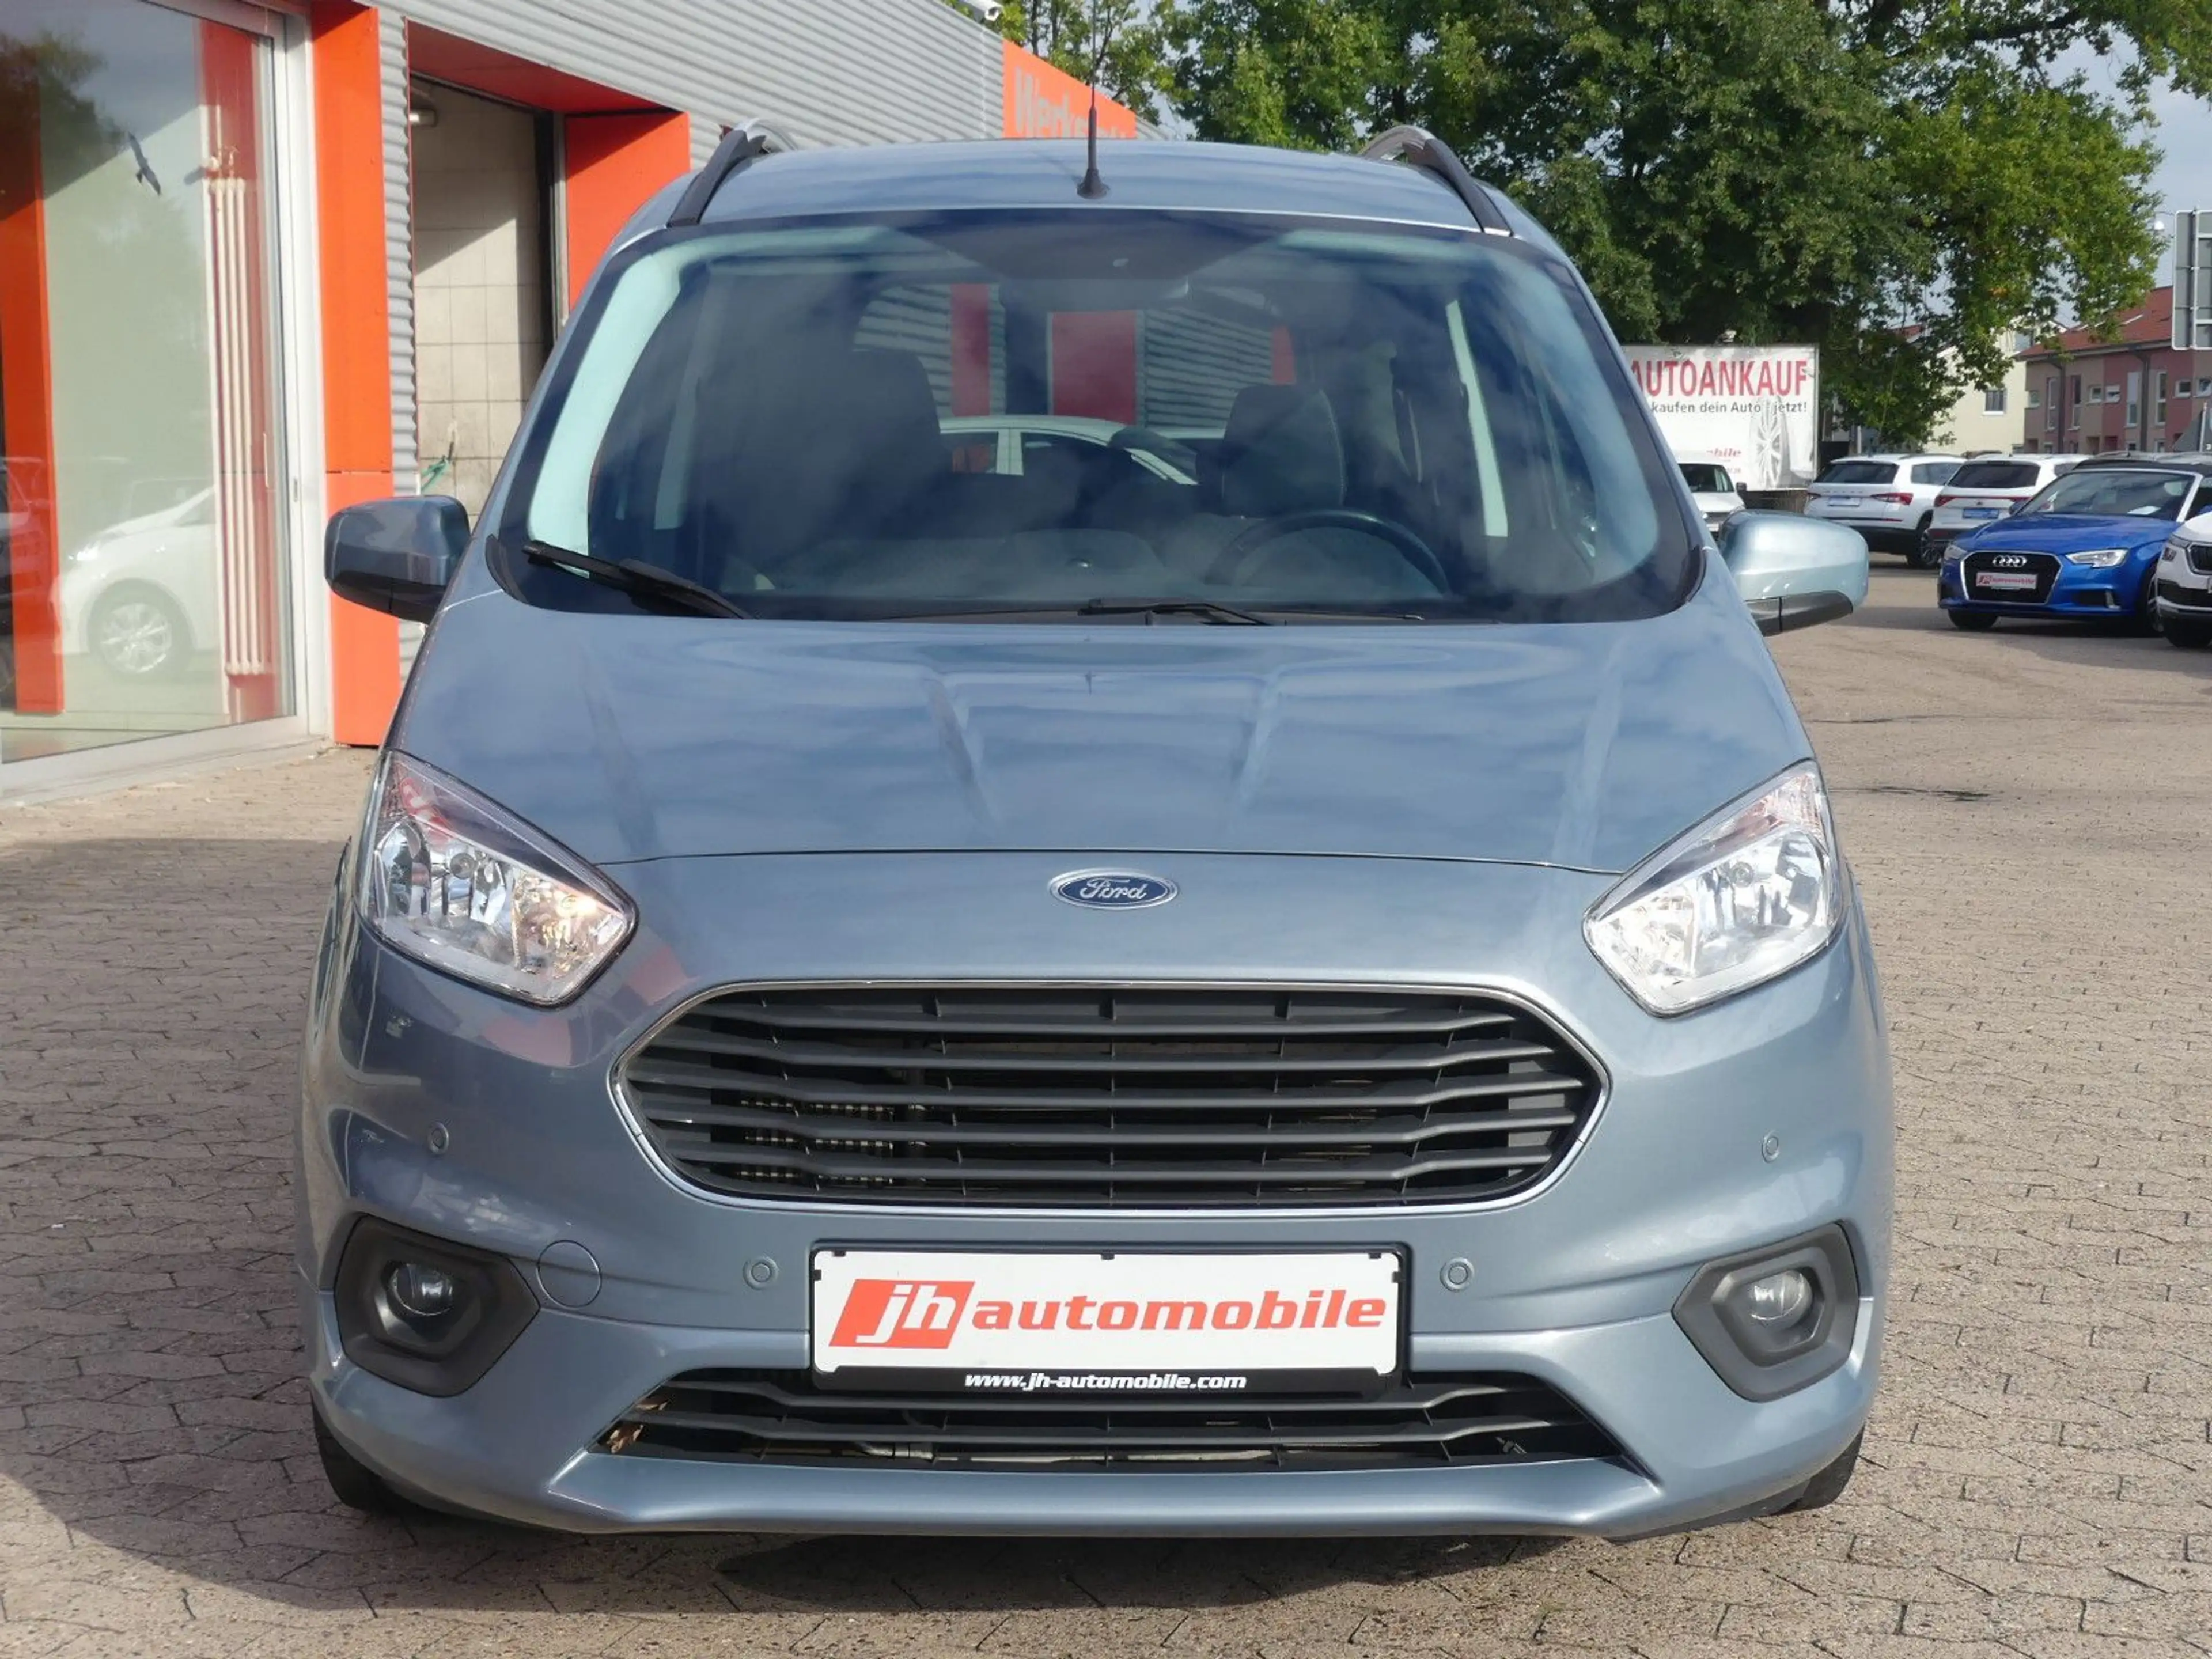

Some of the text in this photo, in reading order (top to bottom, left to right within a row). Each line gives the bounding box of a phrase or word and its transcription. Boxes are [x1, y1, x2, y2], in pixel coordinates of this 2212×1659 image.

[1652, 402, 1695, 413] kaufen
[1700, 402, 1727, 413] dein
[1730, 402, 1761, 413] Auto
[1080, 878, 1148, 899] Ford
[965, 1372, 1247, 1391] www.jh-automobile.com
